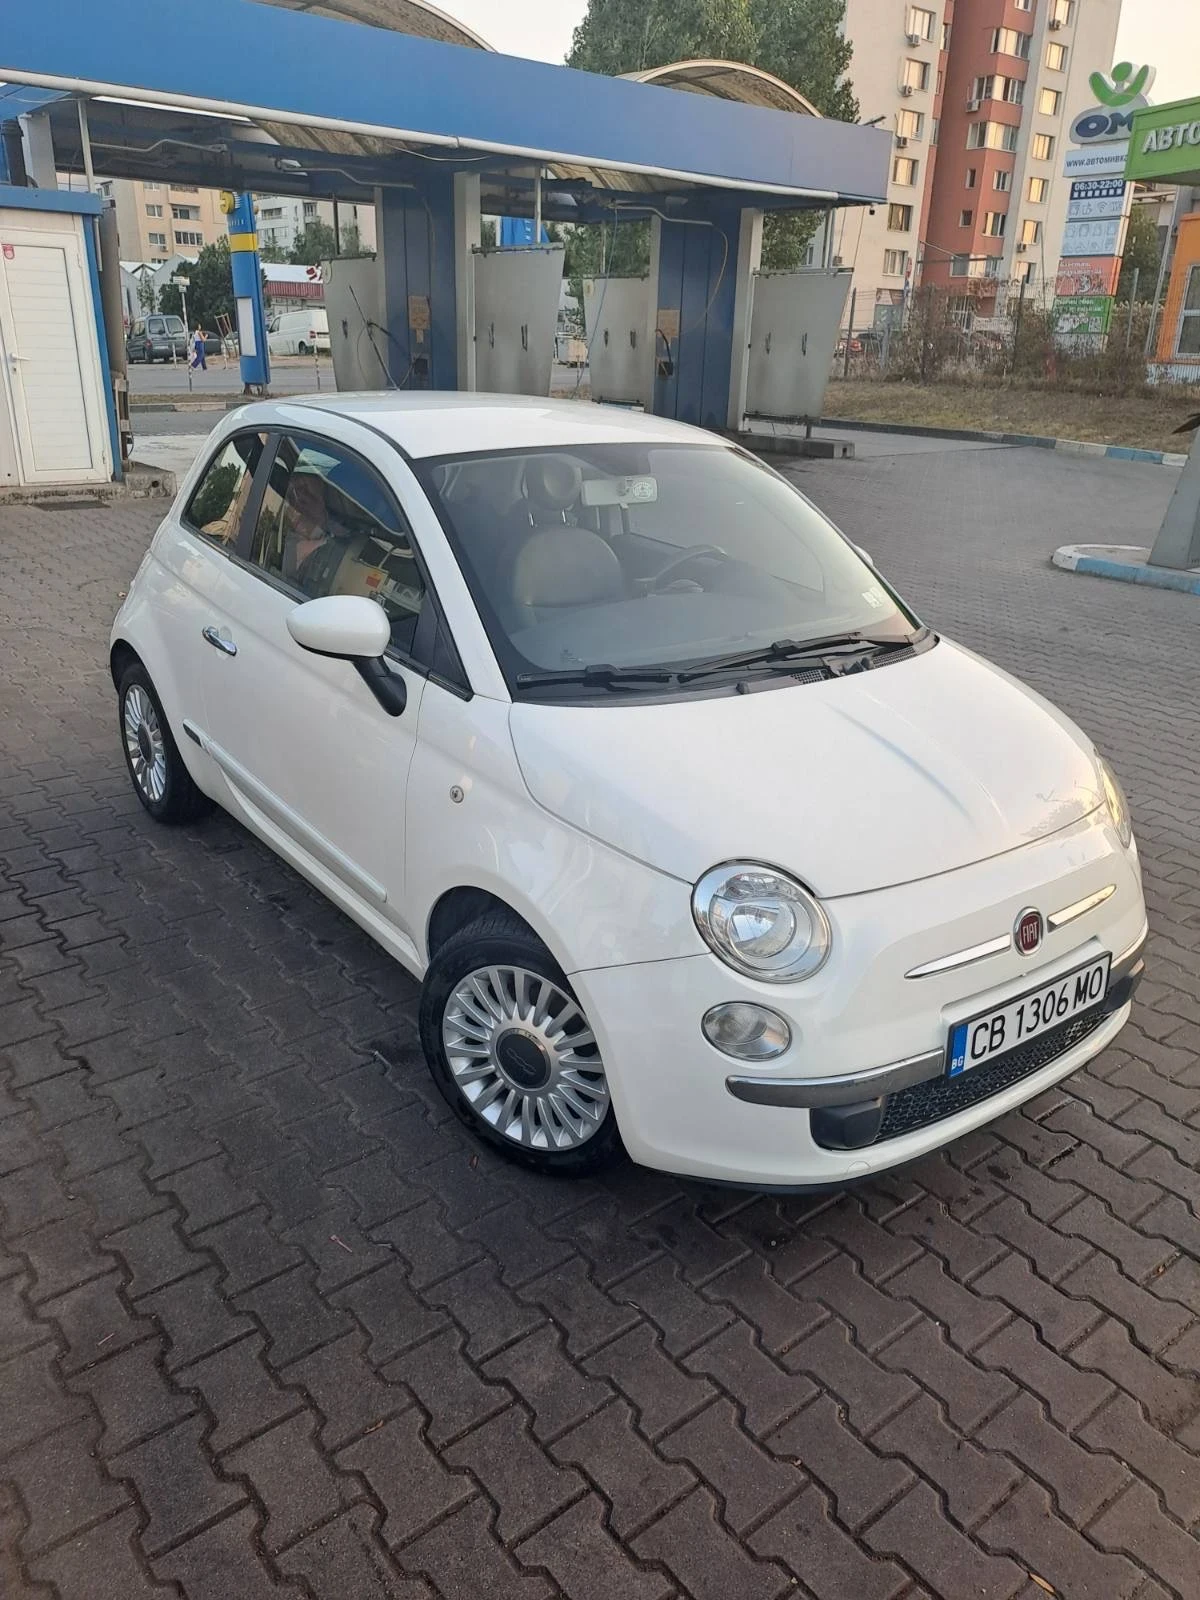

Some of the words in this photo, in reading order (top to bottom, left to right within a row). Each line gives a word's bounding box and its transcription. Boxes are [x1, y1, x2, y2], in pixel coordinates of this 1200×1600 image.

[1022, 921, 1038, 944] FIAT
[970, 1015, 1005, 1060] CB
[1015, 982, 1069, 1039] 1306
[1072, 966, 1103, 1010] MO
[951, 1055, 964, 1070] BG
